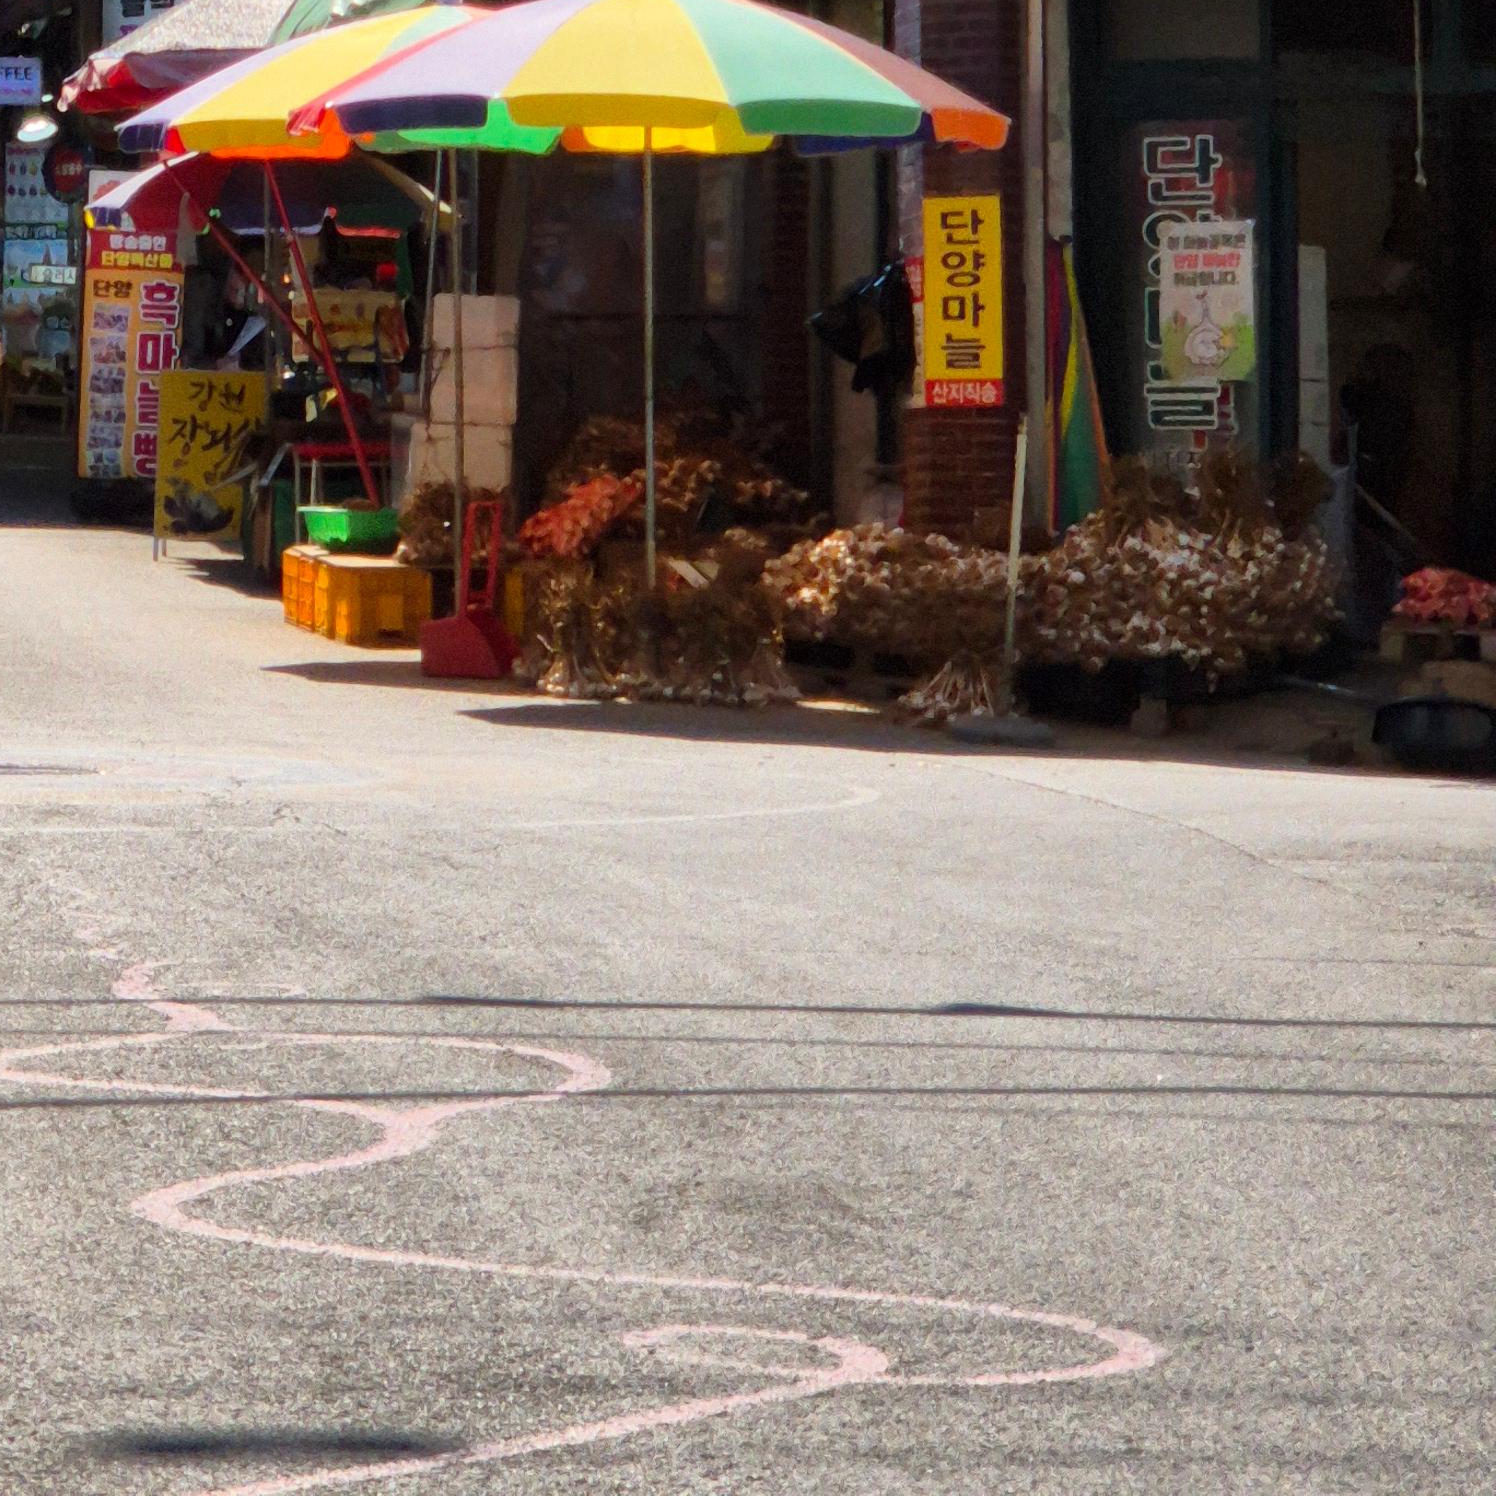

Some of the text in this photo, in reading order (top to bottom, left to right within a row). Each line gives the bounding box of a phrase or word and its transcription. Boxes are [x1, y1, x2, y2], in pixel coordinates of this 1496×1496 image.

[93, 279, 133, 298] 단양
[940, 208, 986, 370] 단양마늘
[932, 380, 998, 405] 산지직송
